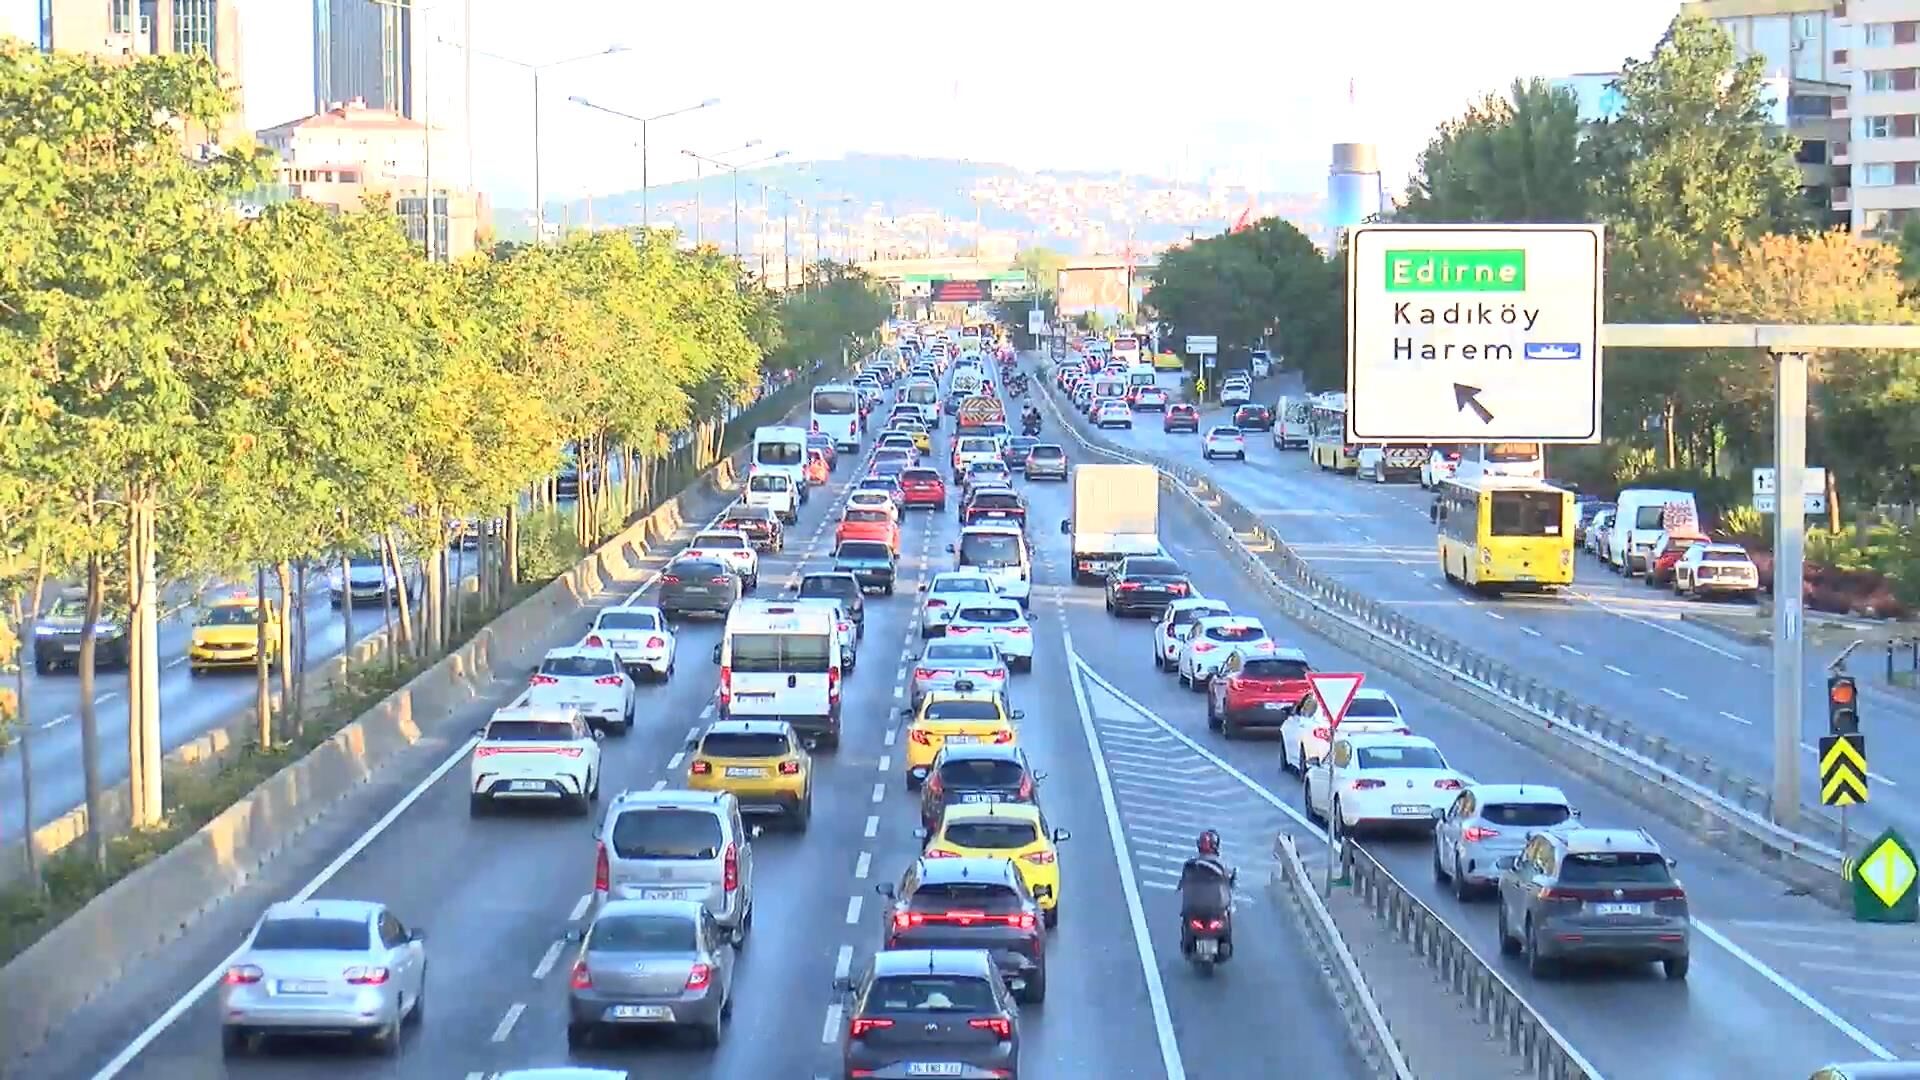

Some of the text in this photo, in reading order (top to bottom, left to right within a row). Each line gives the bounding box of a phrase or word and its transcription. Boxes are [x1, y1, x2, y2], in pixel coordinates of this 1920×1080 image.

[1392, 258, 1517, 284] Edirne
[1394, 302, 1540, 331] Kadıköy
[1393, 337, 1513, 360] Harem
